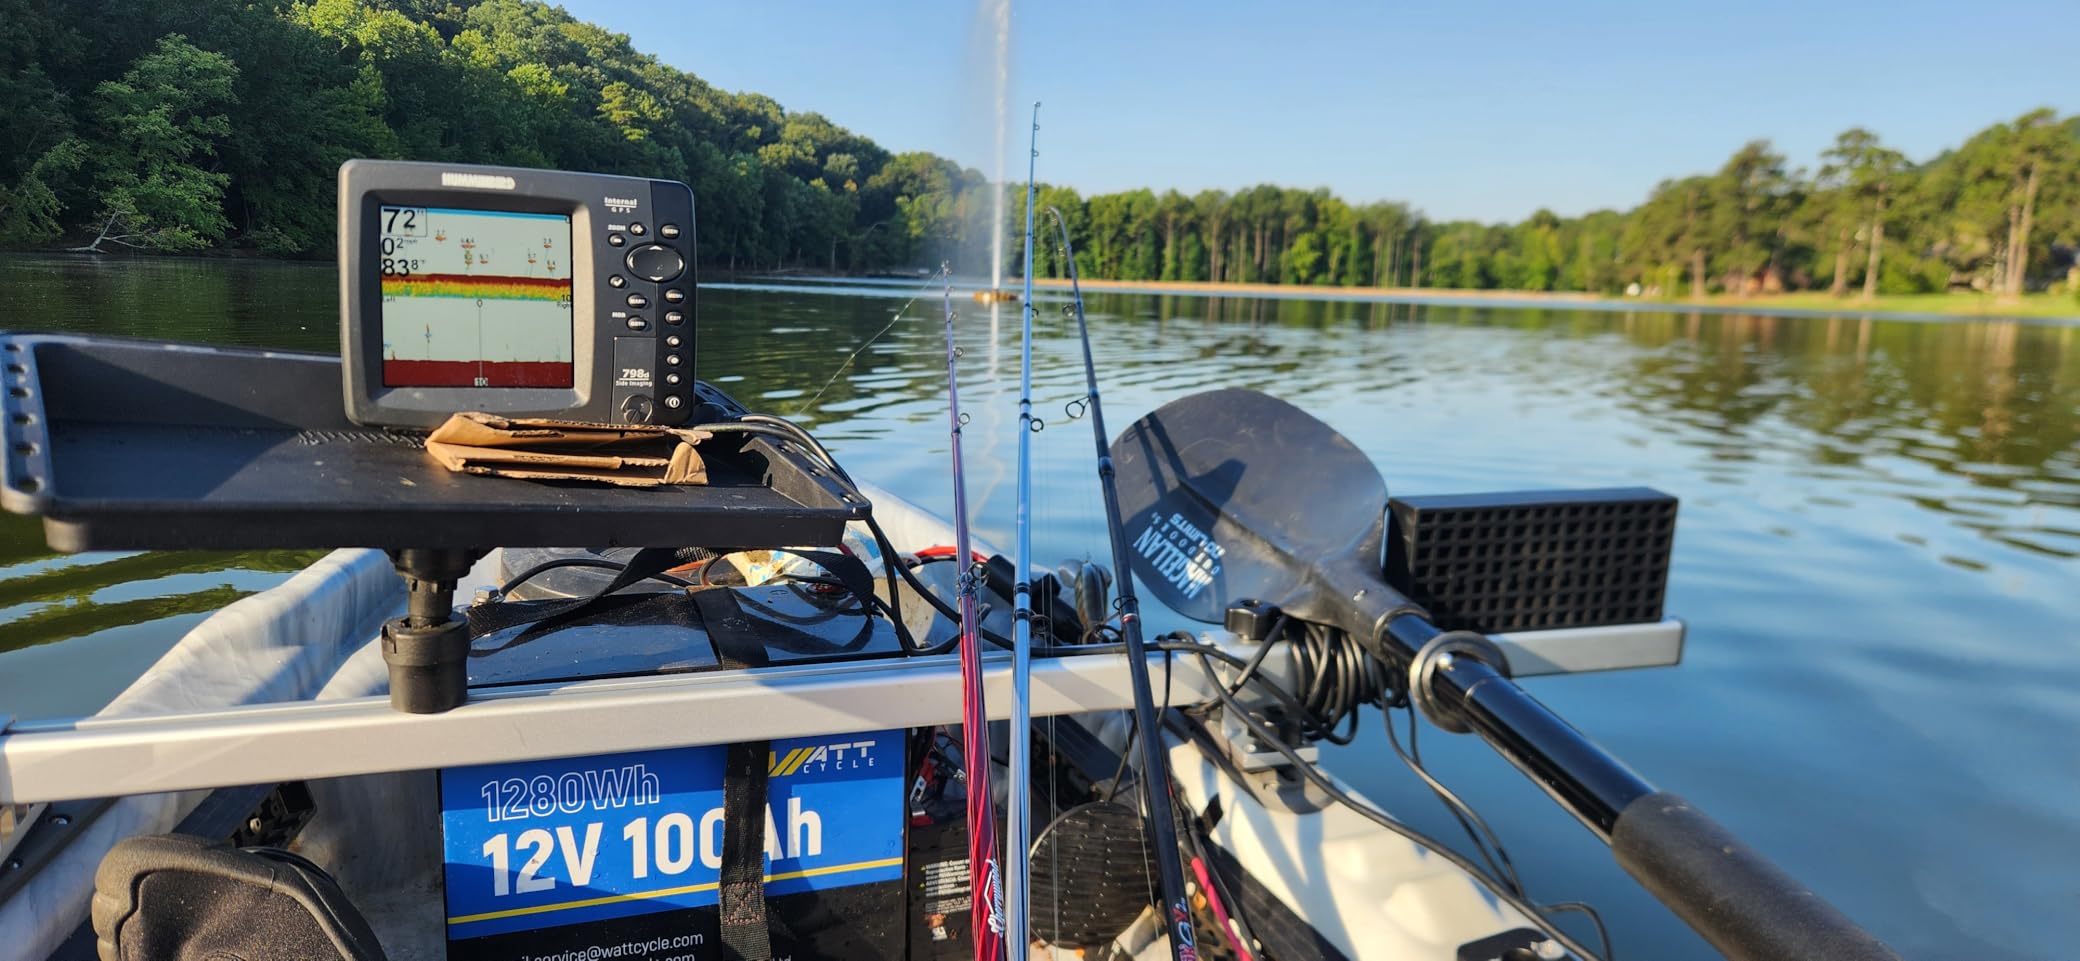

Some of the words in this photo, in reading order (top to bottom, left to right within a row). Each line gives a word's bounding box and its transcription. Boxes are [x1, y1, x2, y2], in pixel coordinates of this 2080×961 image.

[604, 196, 637, 206] Internal
[622, 368, 650, 378] 798d
[1133, 525, 1213, 599] MAGELLAN
[803, 757, 875, 774] CYCLE
[481, 764, 660, 823] 1280Wh
[482, 822, 604, 897] 12V
